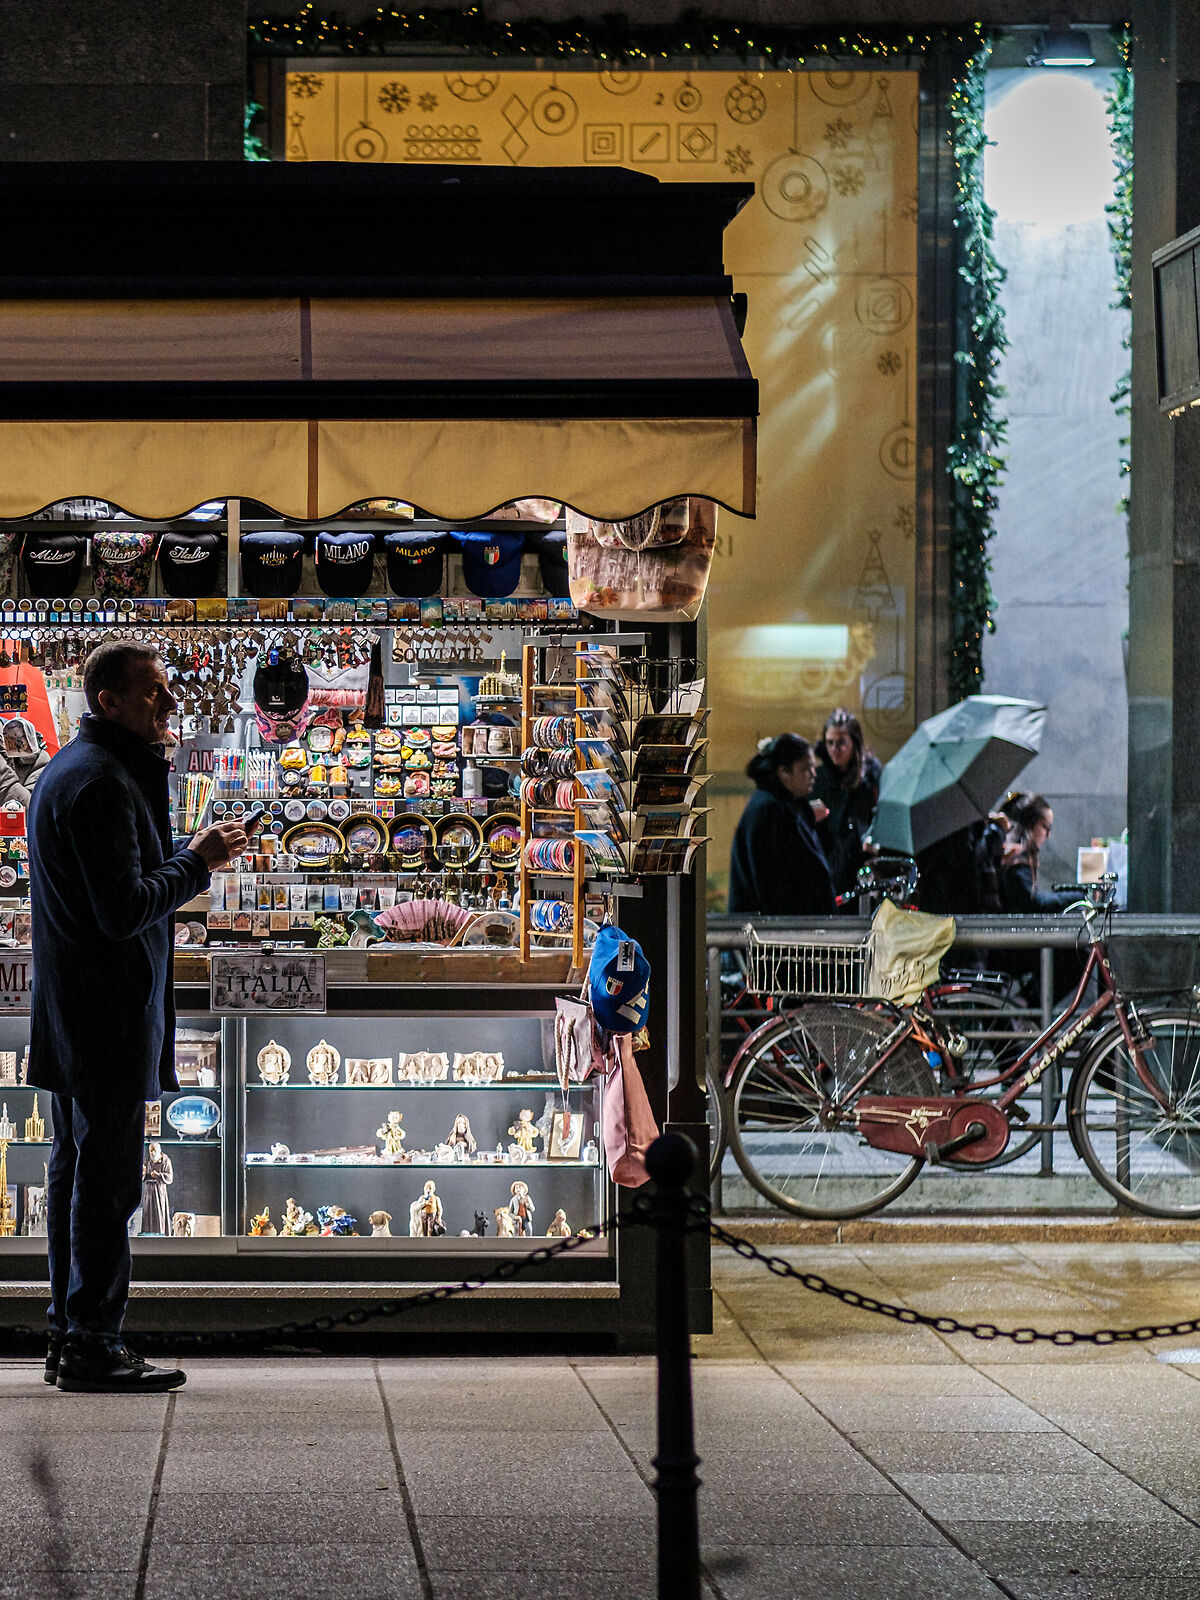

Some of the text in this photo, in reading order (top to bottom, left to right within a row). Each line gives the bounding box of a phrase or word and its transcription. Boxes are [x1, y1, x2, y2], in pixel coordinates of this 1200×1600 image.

[30, 549, 75, 564] Milano
[100, 547, 141, 563] Milano
[169, 546, 210, 564] Italia
[323, 540, 369, 560] MILANO
[395, 546, 435, 558] MILANO
[392, 647, 484, 663] SOUVENIR
[226, 975, 313, 993] ITALIA
